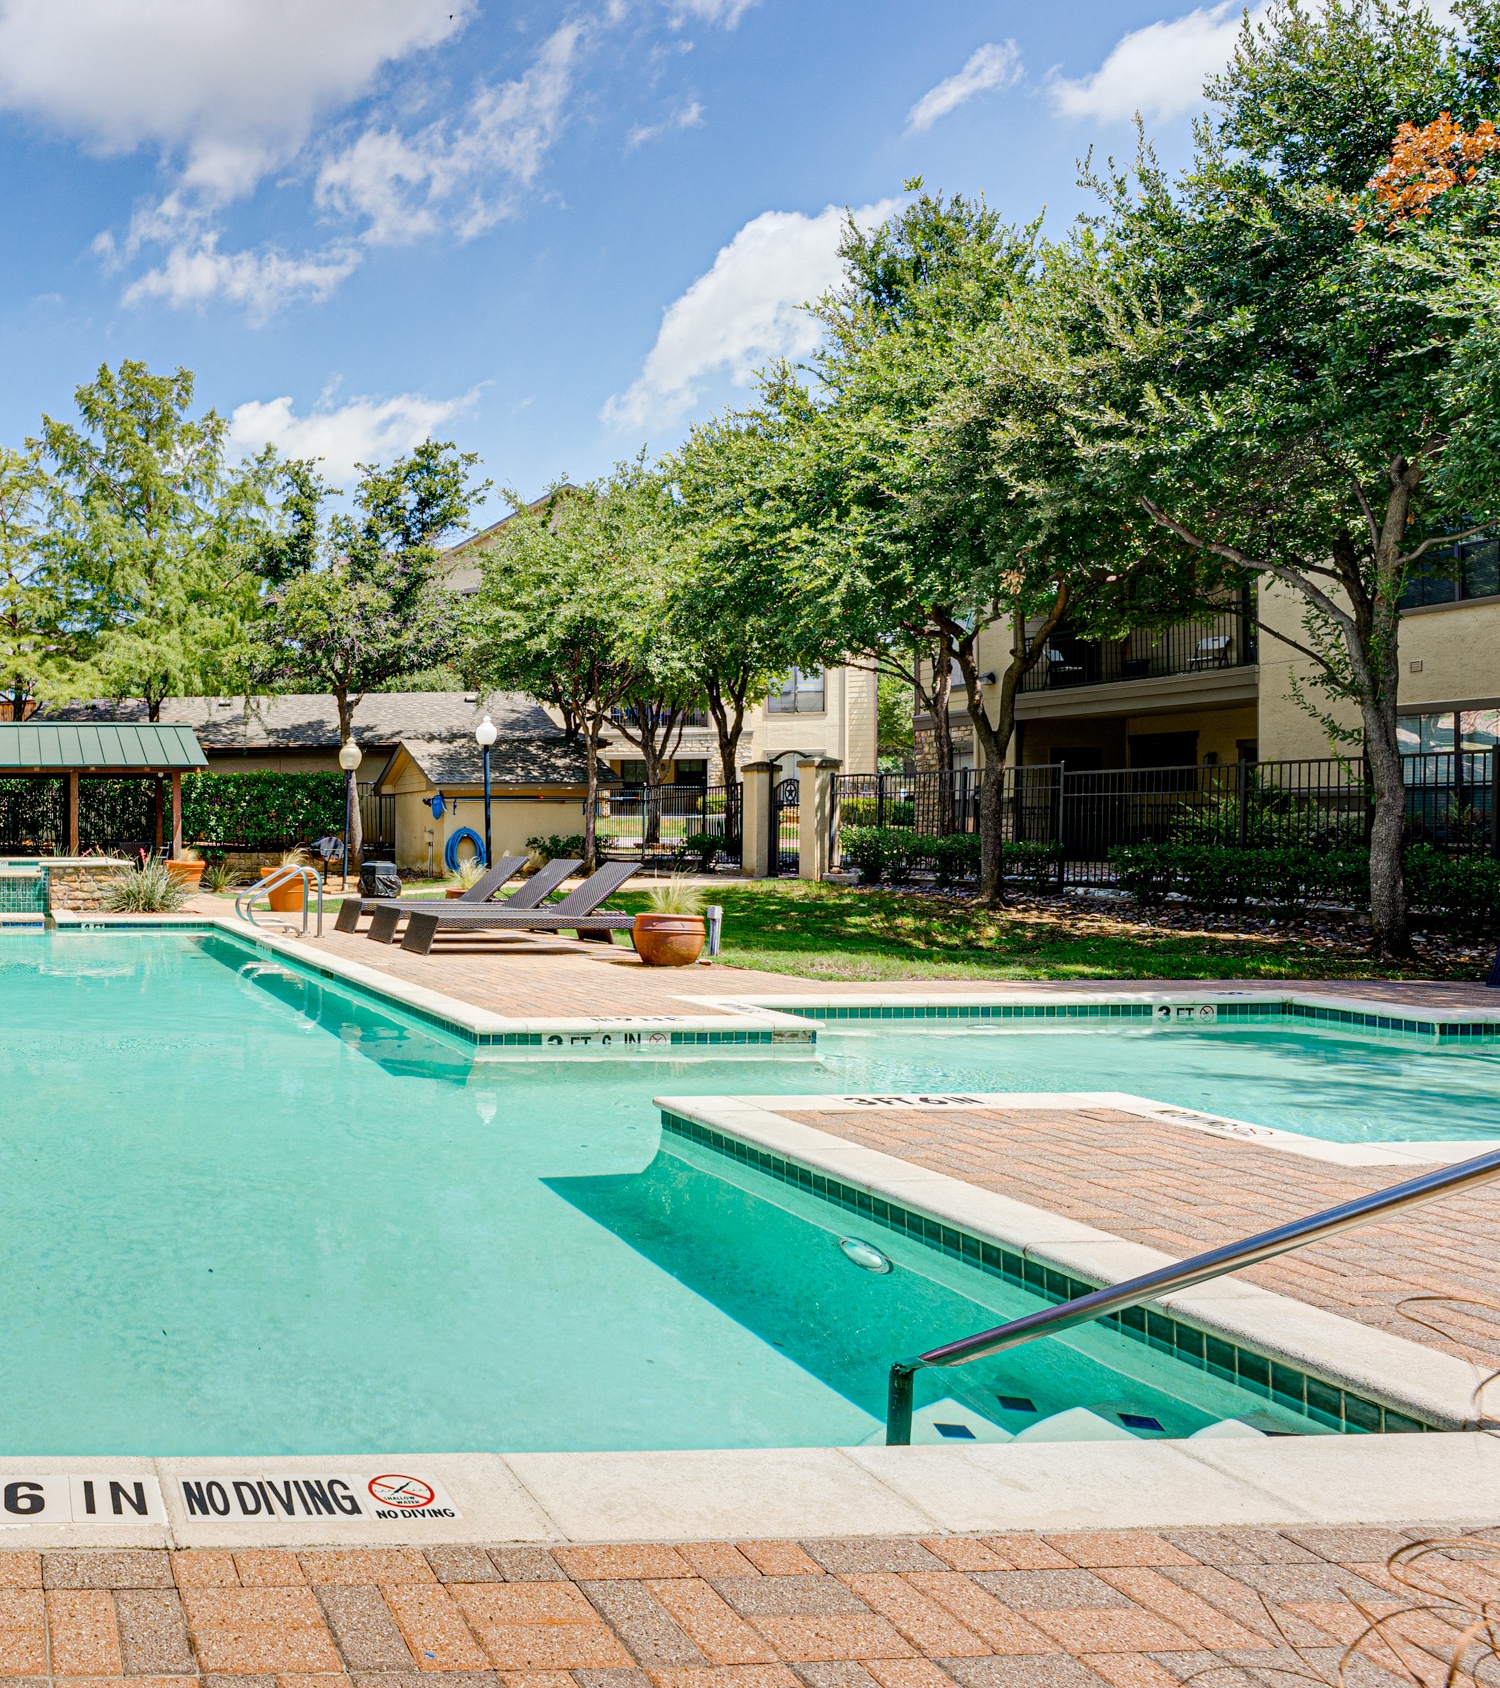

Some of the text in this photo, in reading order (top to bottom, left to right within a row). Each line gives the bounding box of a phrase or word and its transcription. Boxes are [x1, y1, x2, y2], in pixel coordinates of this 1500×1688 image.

[4, 1481, 46, 1515] 6
[83, 1480, 149, 1515] IN
[182, 1479, 363, 1516] NO DIVING
[375, 1508, 456, 1519] NO DIVING
